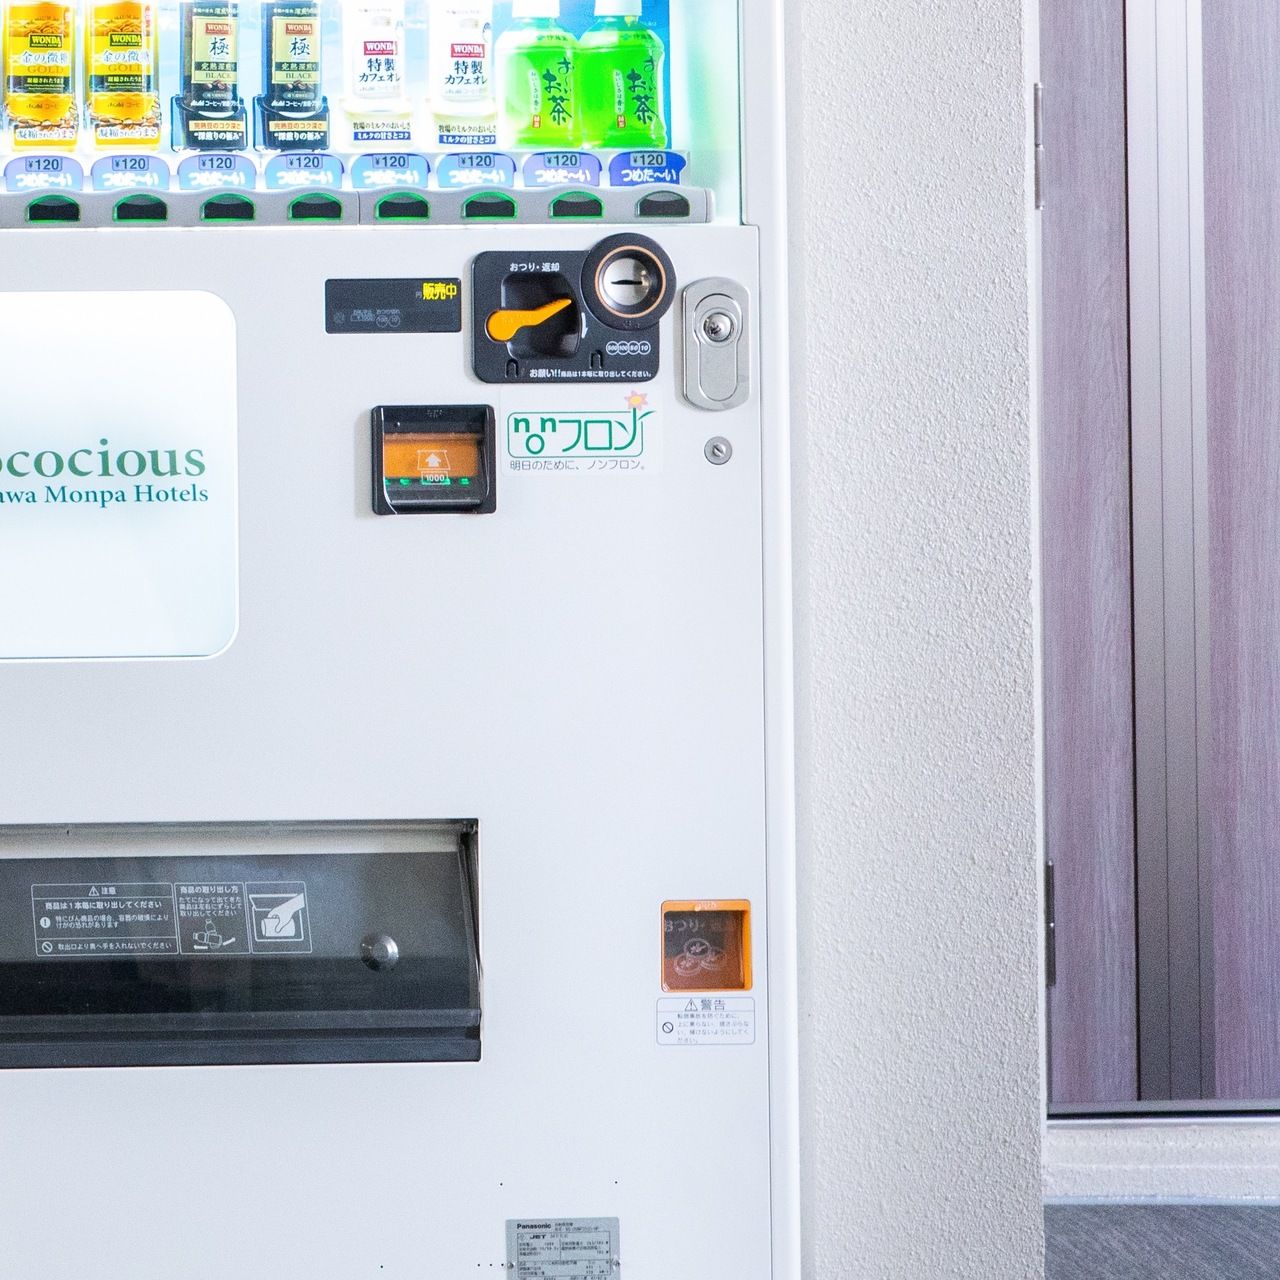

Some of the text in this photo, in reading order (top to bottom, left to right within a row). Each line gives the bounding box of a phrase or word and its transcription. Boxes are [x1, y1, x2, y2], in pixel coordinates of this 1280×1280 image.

[32, 36, 61, 44] WONDA
[209, 37, 230, 56] 極
[290, 37, 310, 56] 極
[453, 45, 483, 54] WONDA
[367, 57, 396, 72] 特製
[454, 60, 483, 75] 特製
[359, 73, 401, 83] カフェオレ
[444, 75, 488, 85] カフェオレ
[28, 158, 59, 170] ¥120
[114, 158, 146, 170] ¥120
[201, 157, 233, 169] ¥120
[289, 156, 320, 168] ¥120
[375, 155, 406, 167] ¥120
[461, 155, 491, 167] ¥120
[547, 154, 578, 166] ¥120
[633, 154, 664, 166] ¥120
[422, 282, 457, 300] 販売中
[510, 459, 645, 471] 明日のために、ノンフロン。
[425, 474, 445, 482] 1000
[44, 484, 126, 508] Monpa
[134, 484, 209, 503] Hotels
